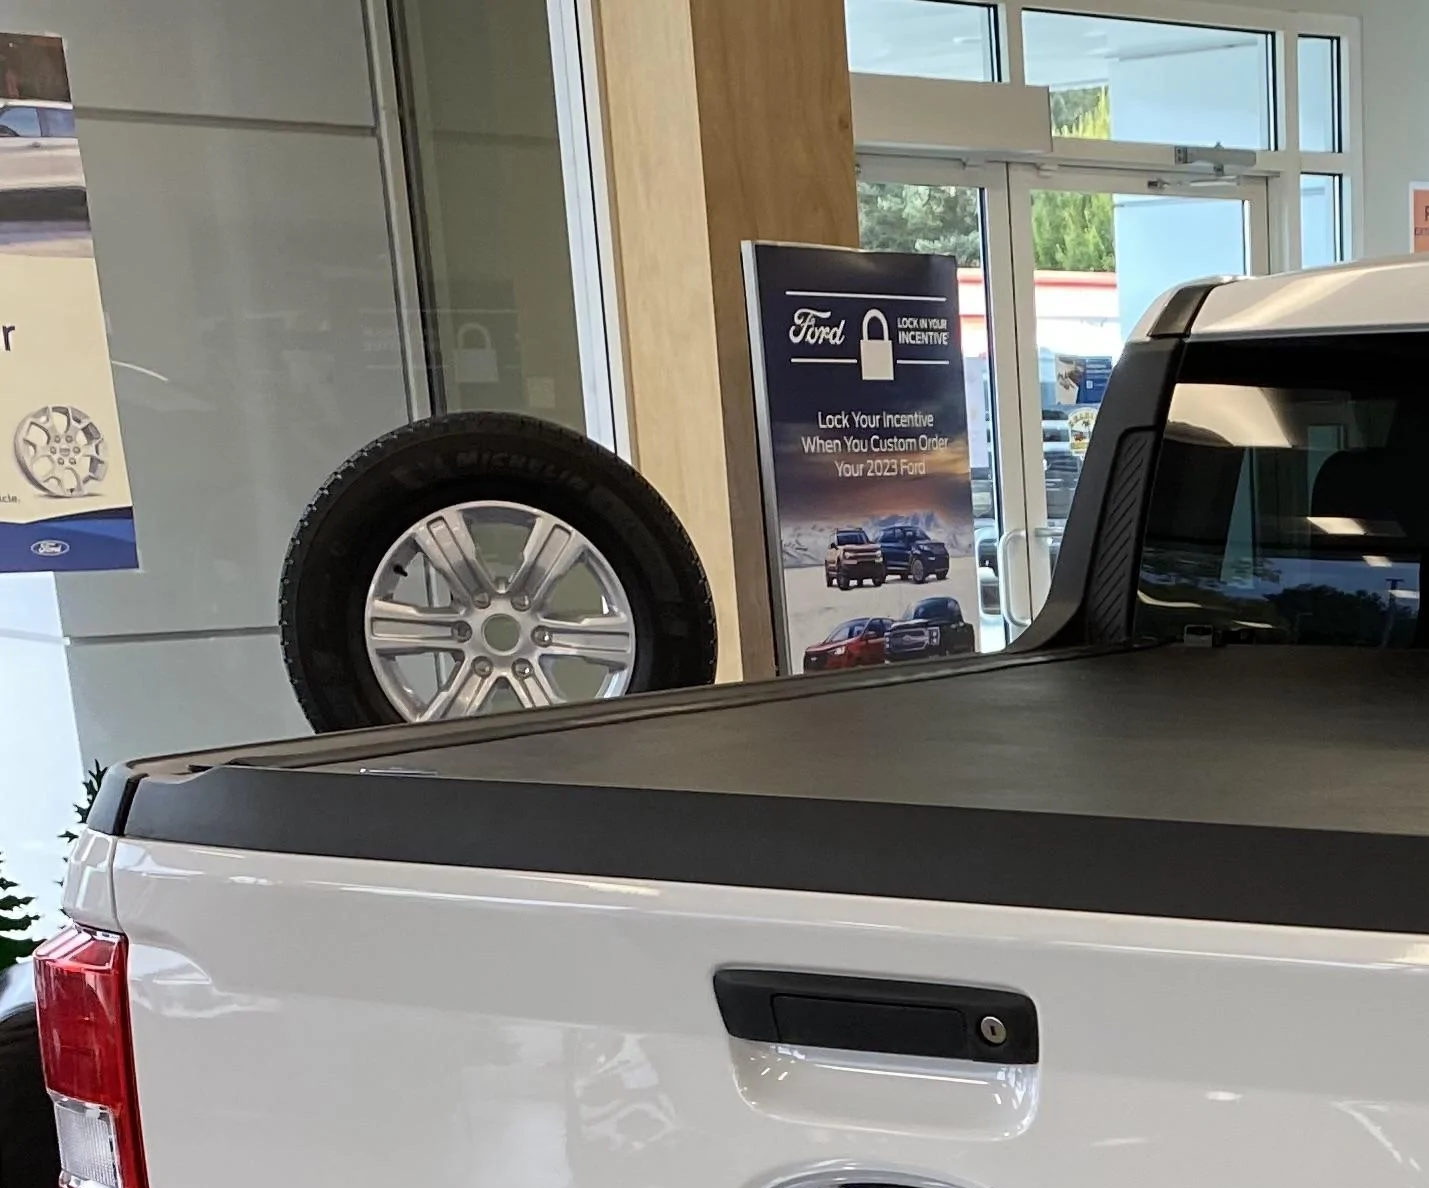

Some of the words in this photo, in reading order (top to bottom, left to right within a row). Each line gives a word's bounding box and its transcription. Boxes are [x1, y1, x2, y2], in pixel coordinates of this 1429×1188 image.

[788, 308, 846, 345] Ford
[897, 317, 919, 329] LOCK
[920, 318, 927, 329] IN
[928, 318, 948, 330] YOUR
[899, 331, 949, 345] INCENTIVE
[818, 411, 850, 429] Lock
[851, 411, 880, 428] Your
[883, 410, 934, 428] Incentive
[801, 436, 841, 453] When
[843, 436, 868, 453] You
[870, 435, 917, 452] Custom
[918, 434, 949, 451] Order
[834, 460, 864, 477] Your
[866, 459, 897, 477] 2023
[900, 459, 926, 476] Ford
